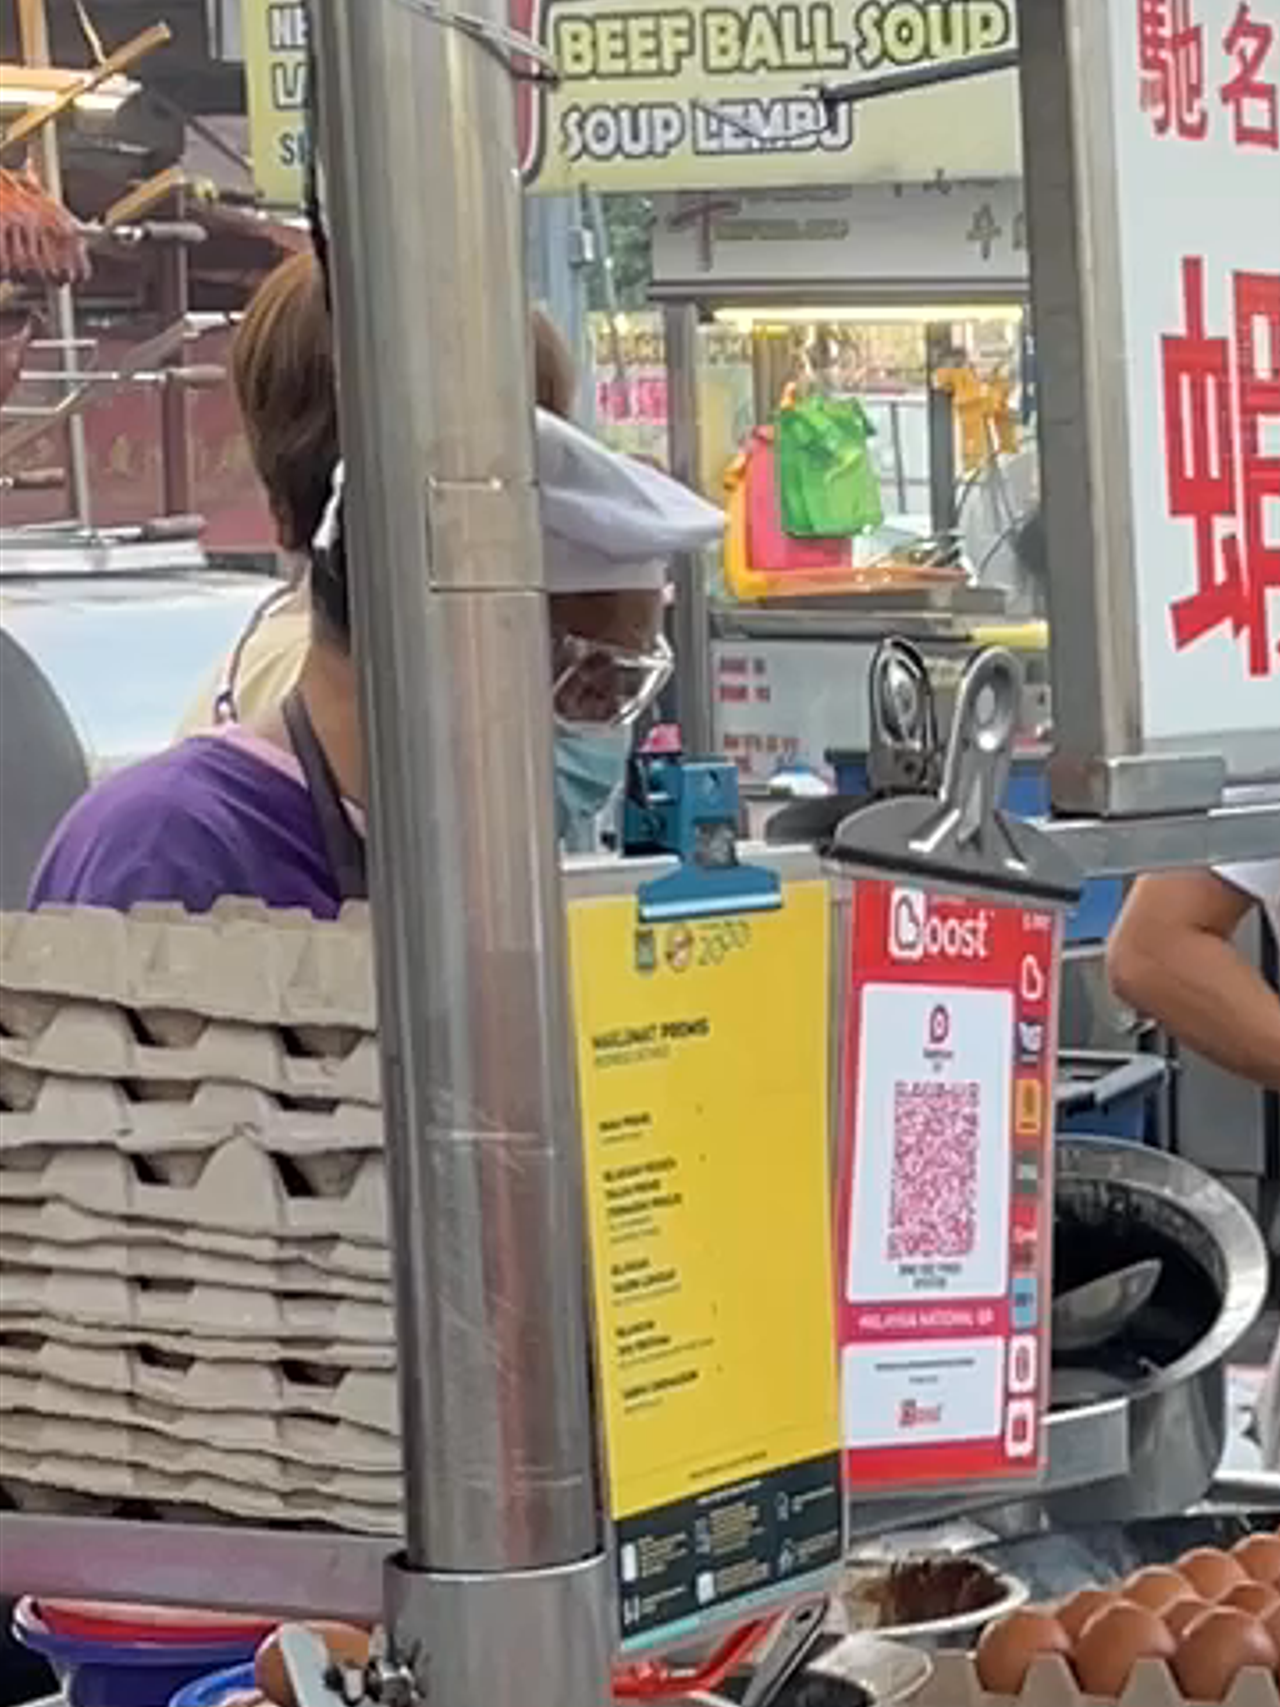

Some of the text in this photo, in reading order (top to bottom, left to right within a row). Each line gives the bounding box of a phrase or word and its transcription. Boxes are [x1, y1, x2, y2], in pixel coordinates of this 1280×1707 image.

[556, 13, 694, 83] BEEF
[702, 4, 850, 74] BALL
[561, 103, 686, 159] SOUP
